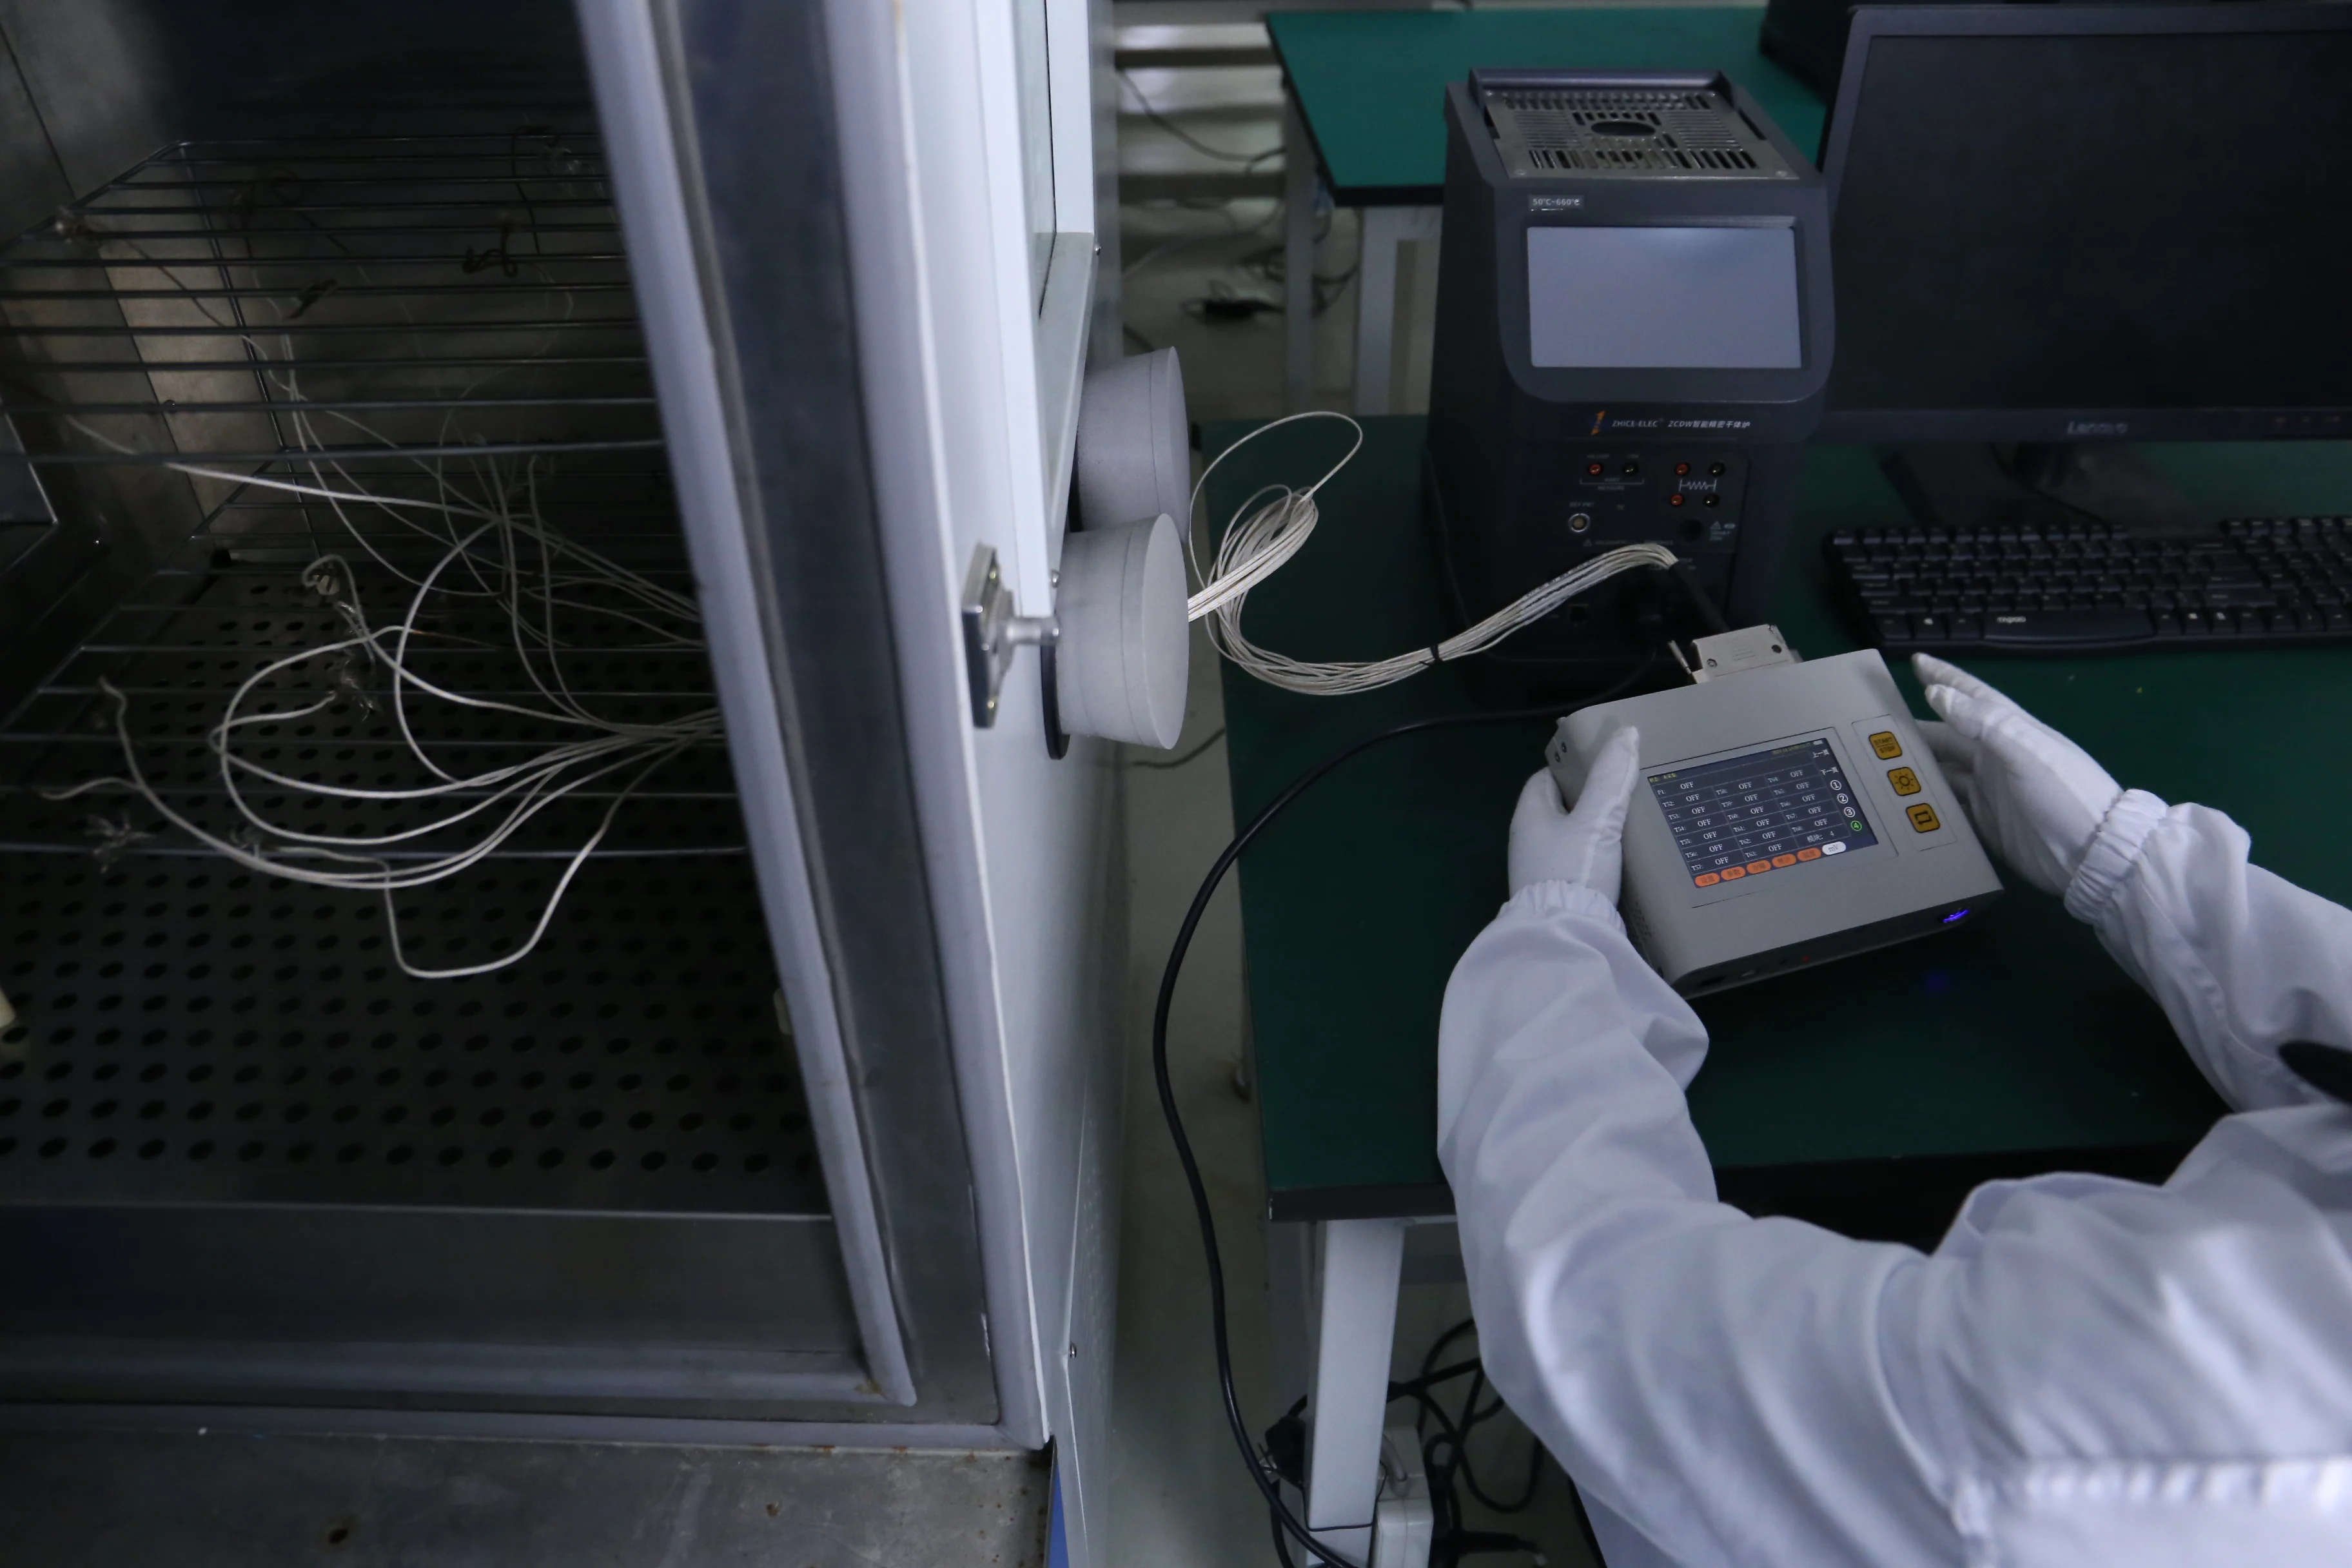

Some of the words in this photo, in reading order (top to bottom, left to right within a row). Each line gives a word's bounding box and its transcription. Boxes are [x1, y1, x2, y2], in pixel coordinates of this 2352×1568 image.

[1813, 749, 1829, 758] 上一页
[1820, 767, 1838, 775] 下一页
